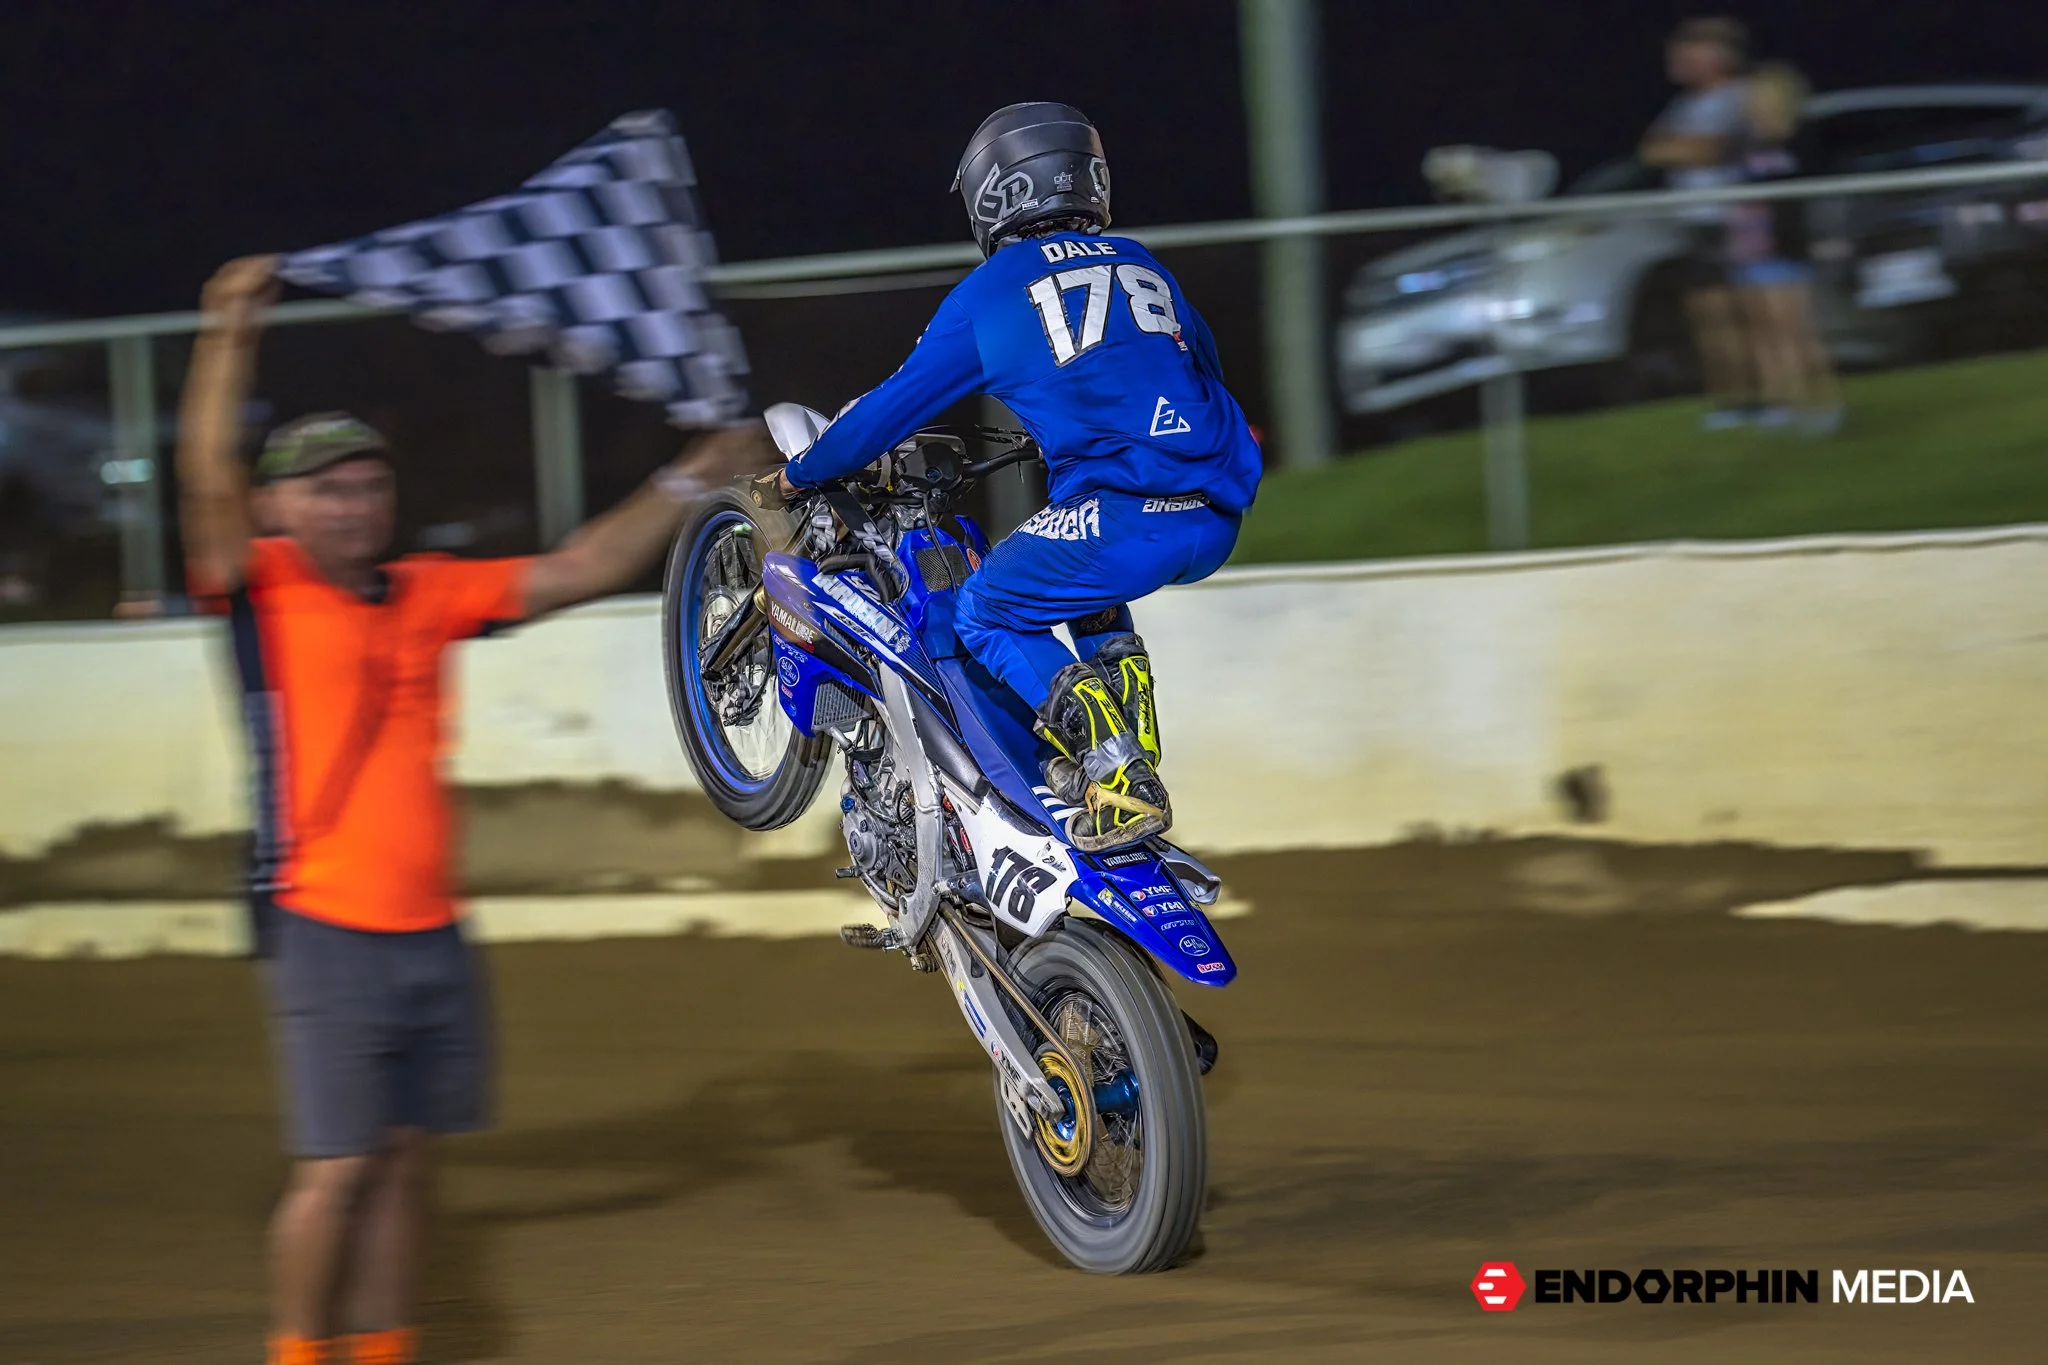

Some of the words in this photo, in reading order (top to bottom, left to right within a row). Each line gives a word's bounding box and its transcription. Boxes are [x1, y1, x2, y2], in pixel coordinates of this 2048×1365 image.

[1040, 240, 1117, 263] DALE
[1025, 263, 1179, 368] 178
[985, 845, 1058, 923] 178
[1143, 885, 1174, 895] YMF
[1157, 901, 1186, 911] YMI
